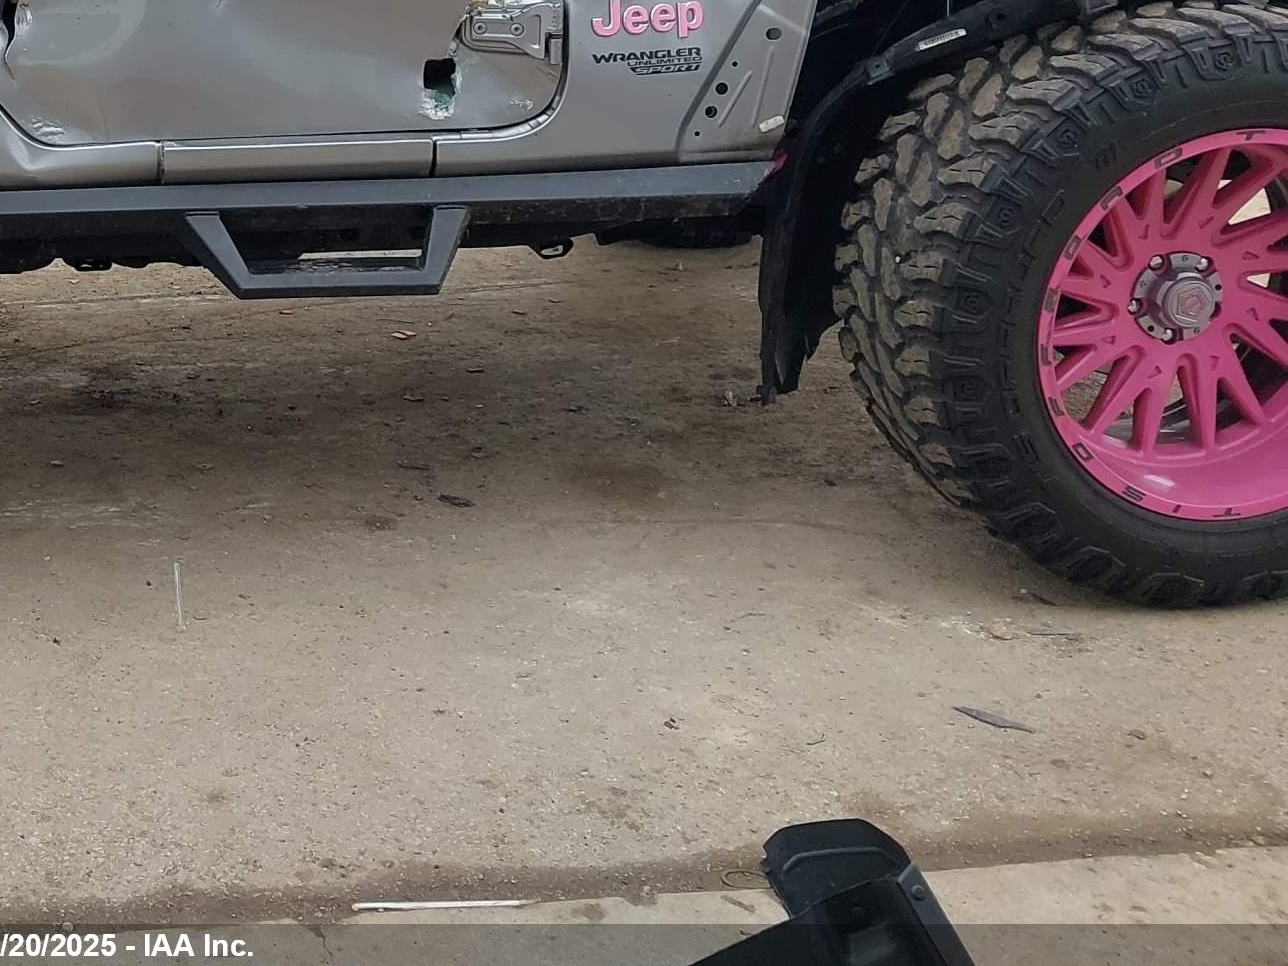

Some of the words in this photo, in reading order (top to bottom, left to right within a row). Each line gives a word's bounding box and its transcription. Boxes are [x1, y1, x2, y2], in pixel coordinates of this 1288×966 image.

[592, 47, 702, 64] WRANGLER
[627, 56, 703, 67] UNLIMITED
[634, 64, 701, 74] SPORT
